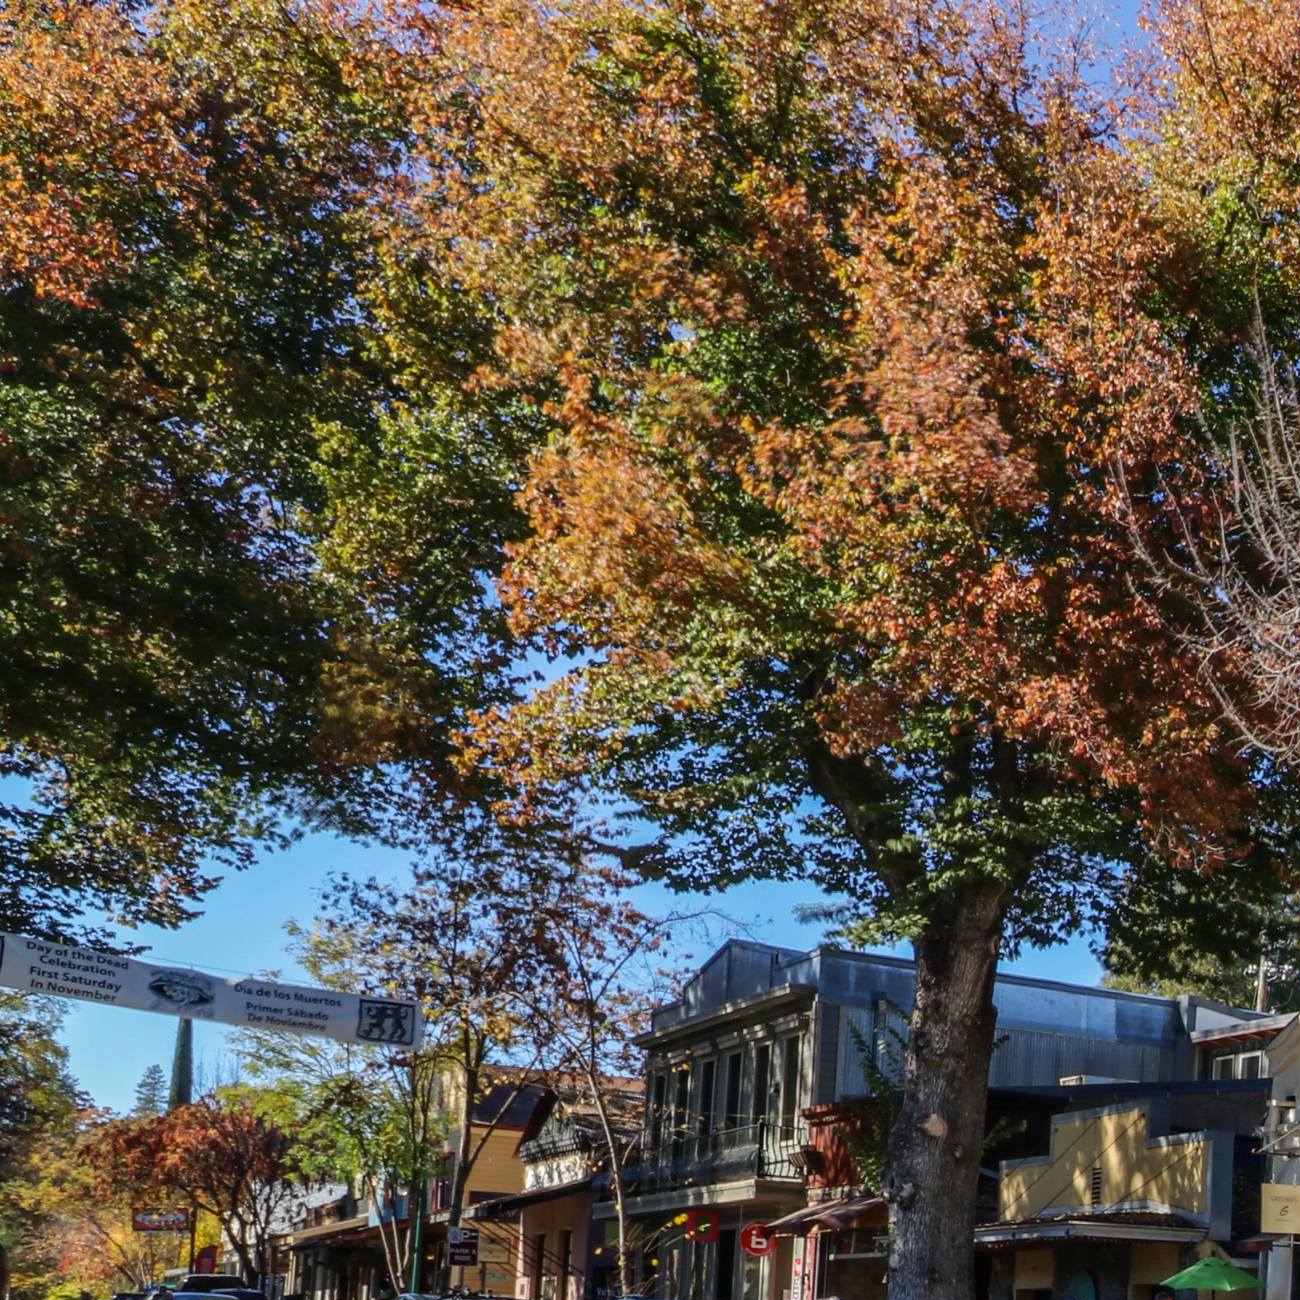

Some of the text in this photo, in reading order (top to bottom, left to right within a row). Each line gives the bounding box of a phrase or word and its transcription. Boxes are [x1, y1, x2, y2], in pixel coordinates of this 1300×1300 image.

[26, 941, 129, 970] Day of the Dead
[39, 954, 116, 978] Celebration
[29, 966, 122, 993] First Saturday
[30, 978, 118, 1003] In November
[246, 1002, 284, 1016] Primer
[256, 987, 271, 998] de
[274, 989, 291, 1001] los
[294, 993, 342, 1008] Muertos
[247, 1012, 327, 1032] De Noviembre
